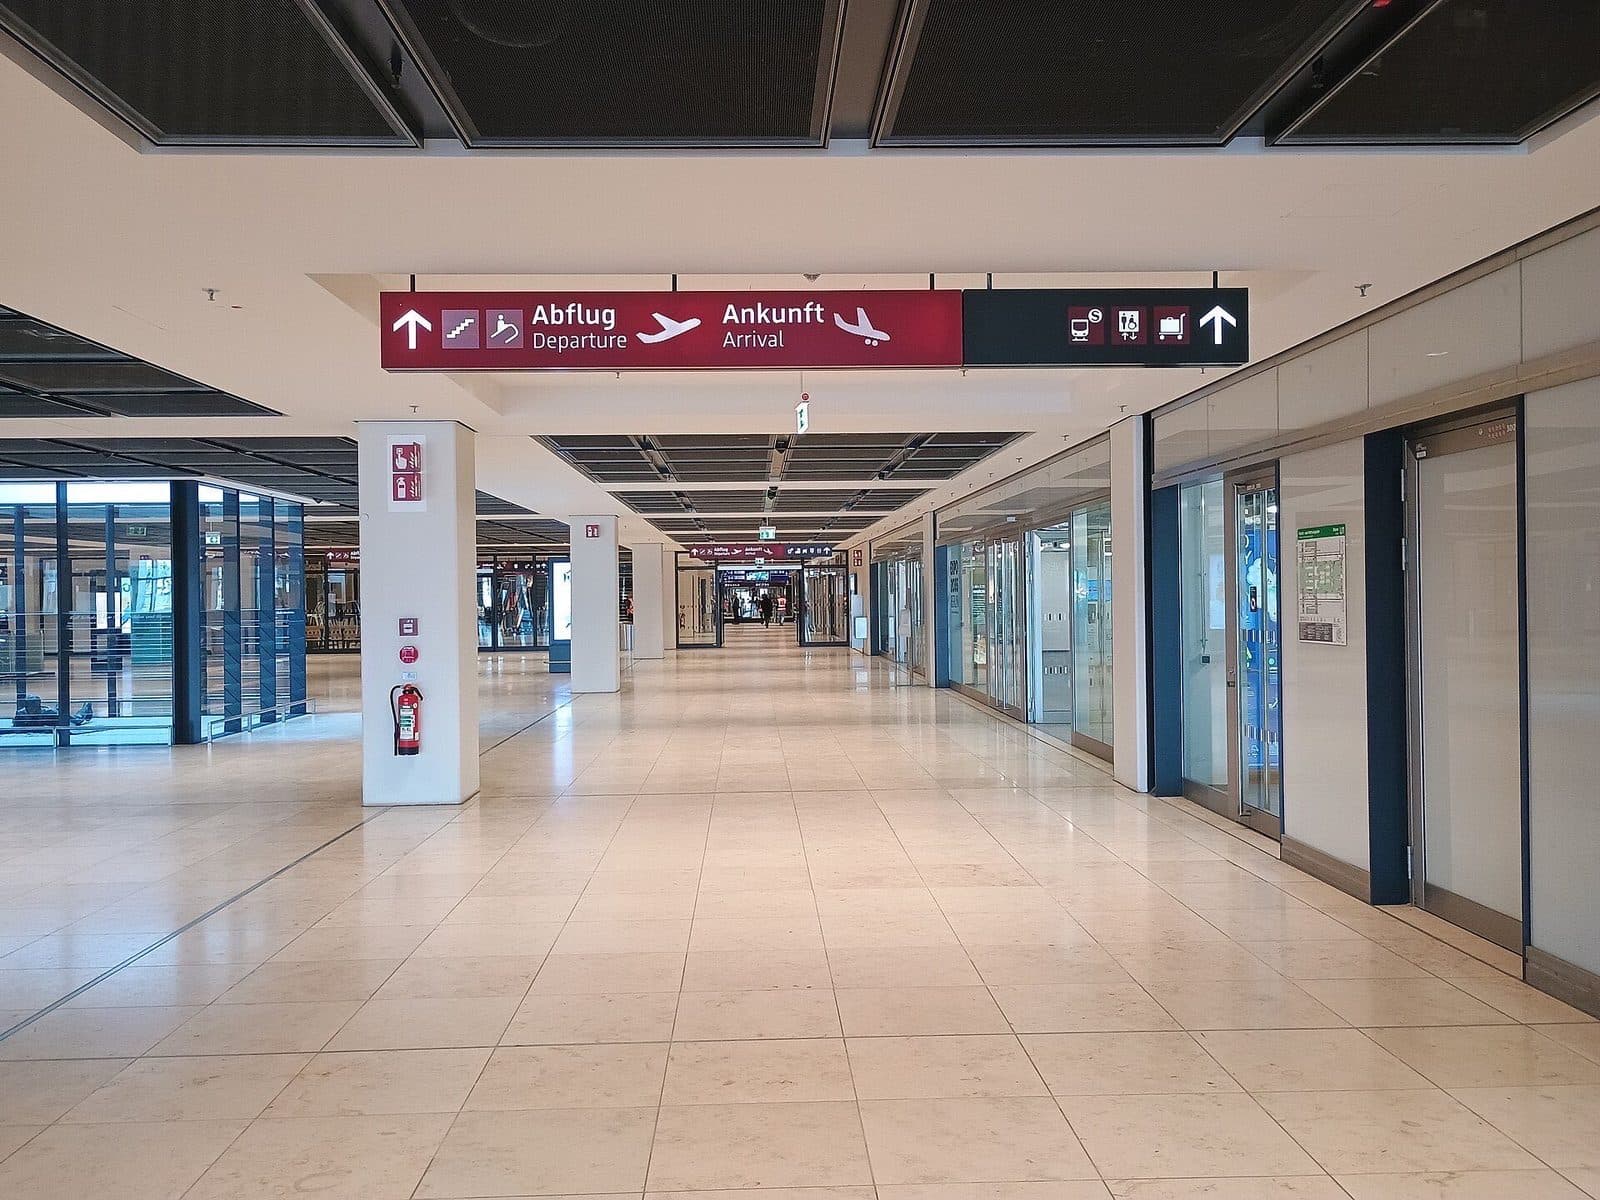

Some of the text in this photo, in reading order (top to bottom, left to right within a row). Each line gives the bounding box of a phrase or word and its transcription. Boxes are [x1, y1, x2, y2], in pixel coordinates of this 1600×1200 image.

[531, 303, 616, 331] Abflug
[722, 301, 825, 324] Ankunft
[533, 332, 628, 353] Departure
[722, 330, 785, 348] Arrival
